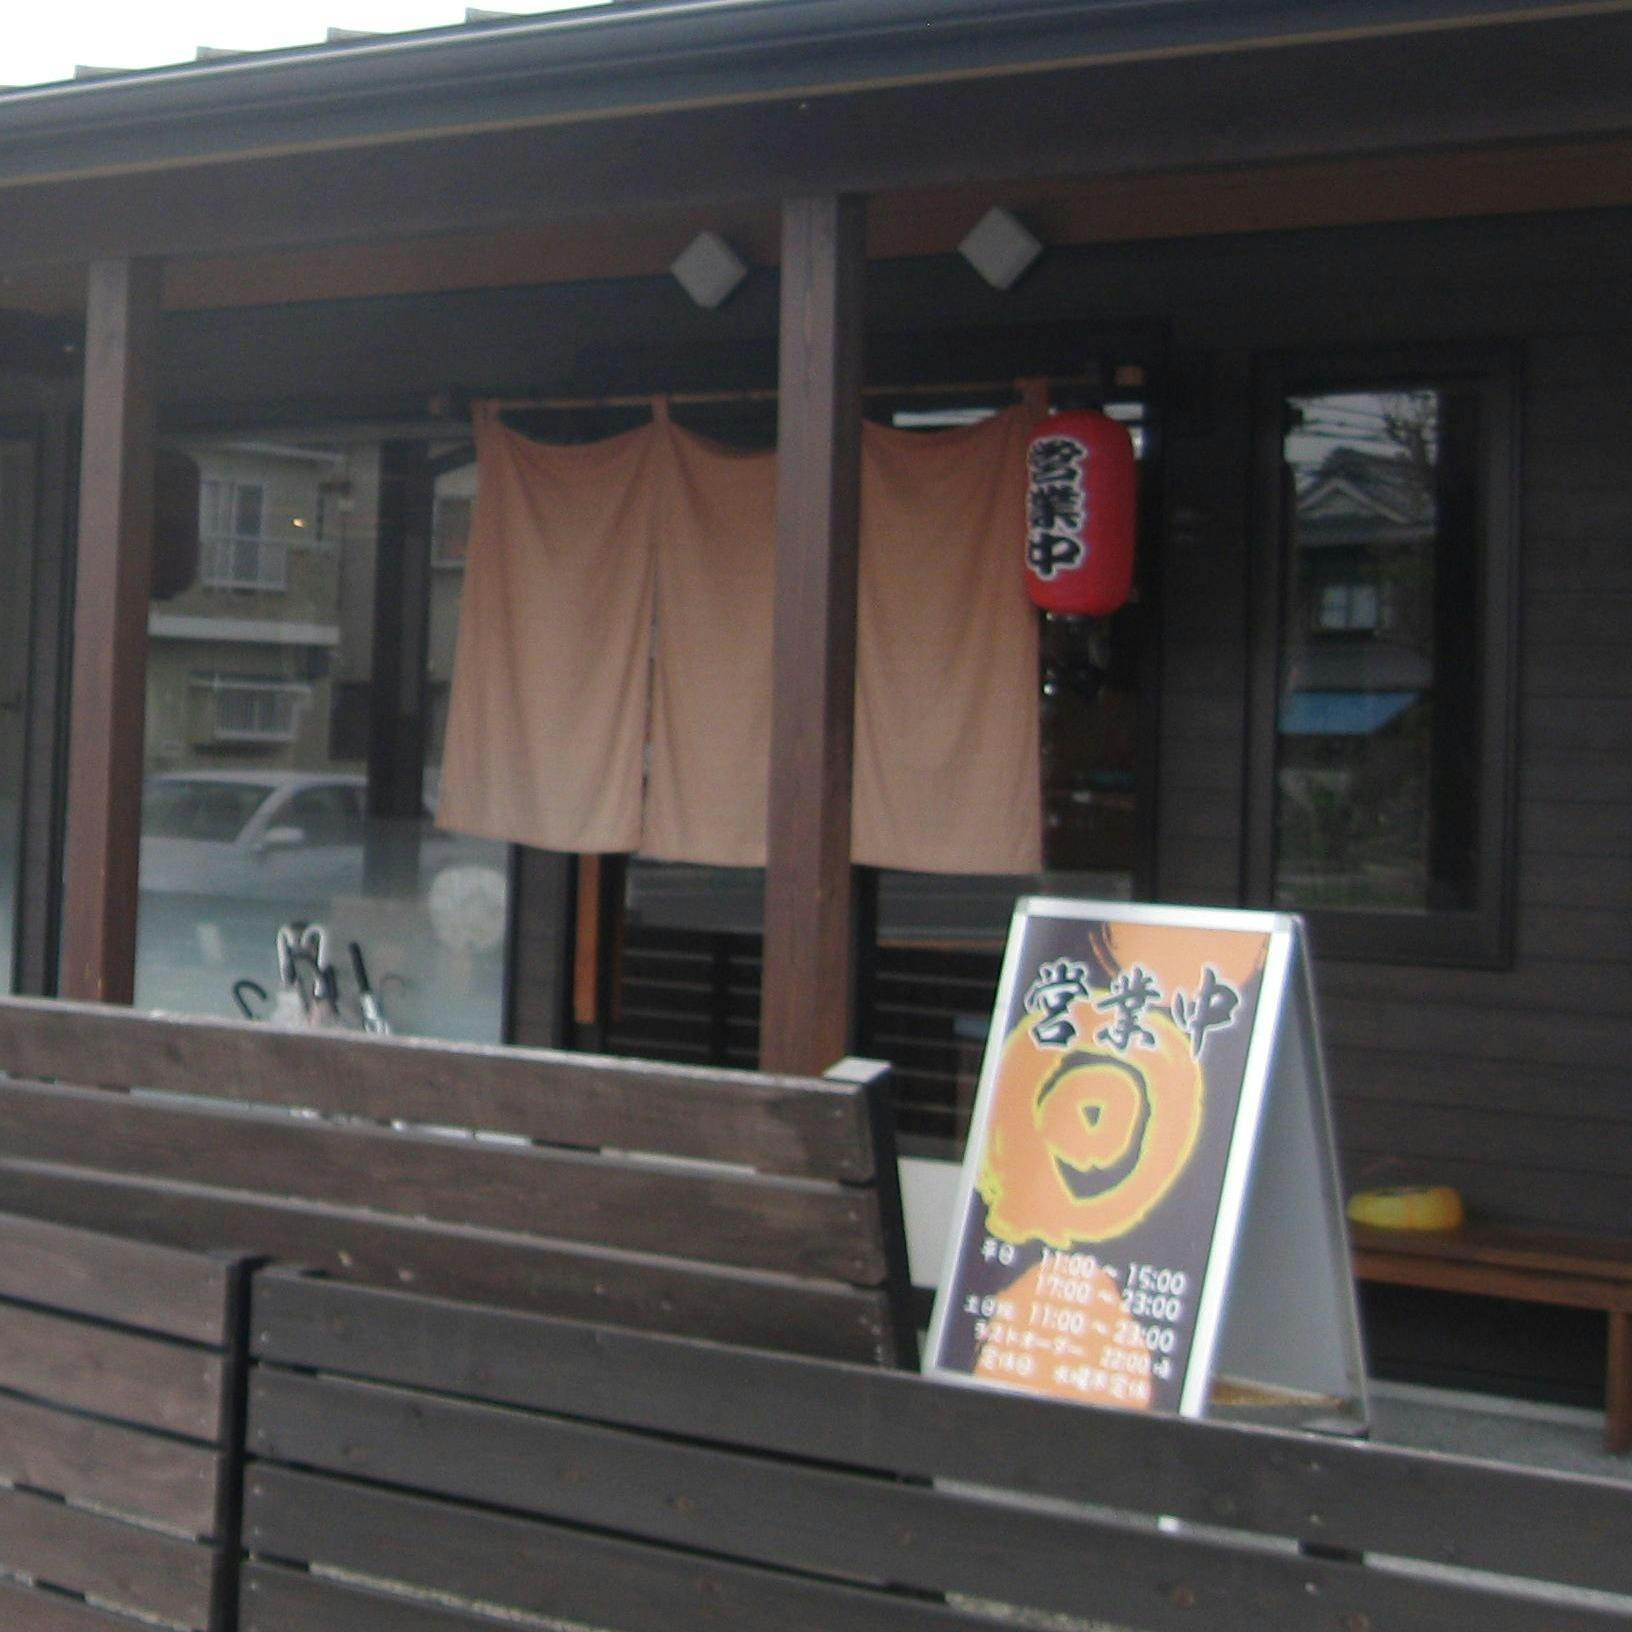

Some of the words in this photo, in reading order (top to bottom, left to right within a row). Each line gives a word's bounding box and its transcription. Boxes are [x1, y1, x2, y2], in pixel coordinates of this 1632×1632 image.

[1027, 436, 1089, 582] 営業中
[1023, 957, 1241, 1063] 営業中
[1040, 1246, 1097, 1278] 11:00
[1126, 1261, 1187, 1295] 15:00
[1028, 1301, 1086, 1334] 11:00
